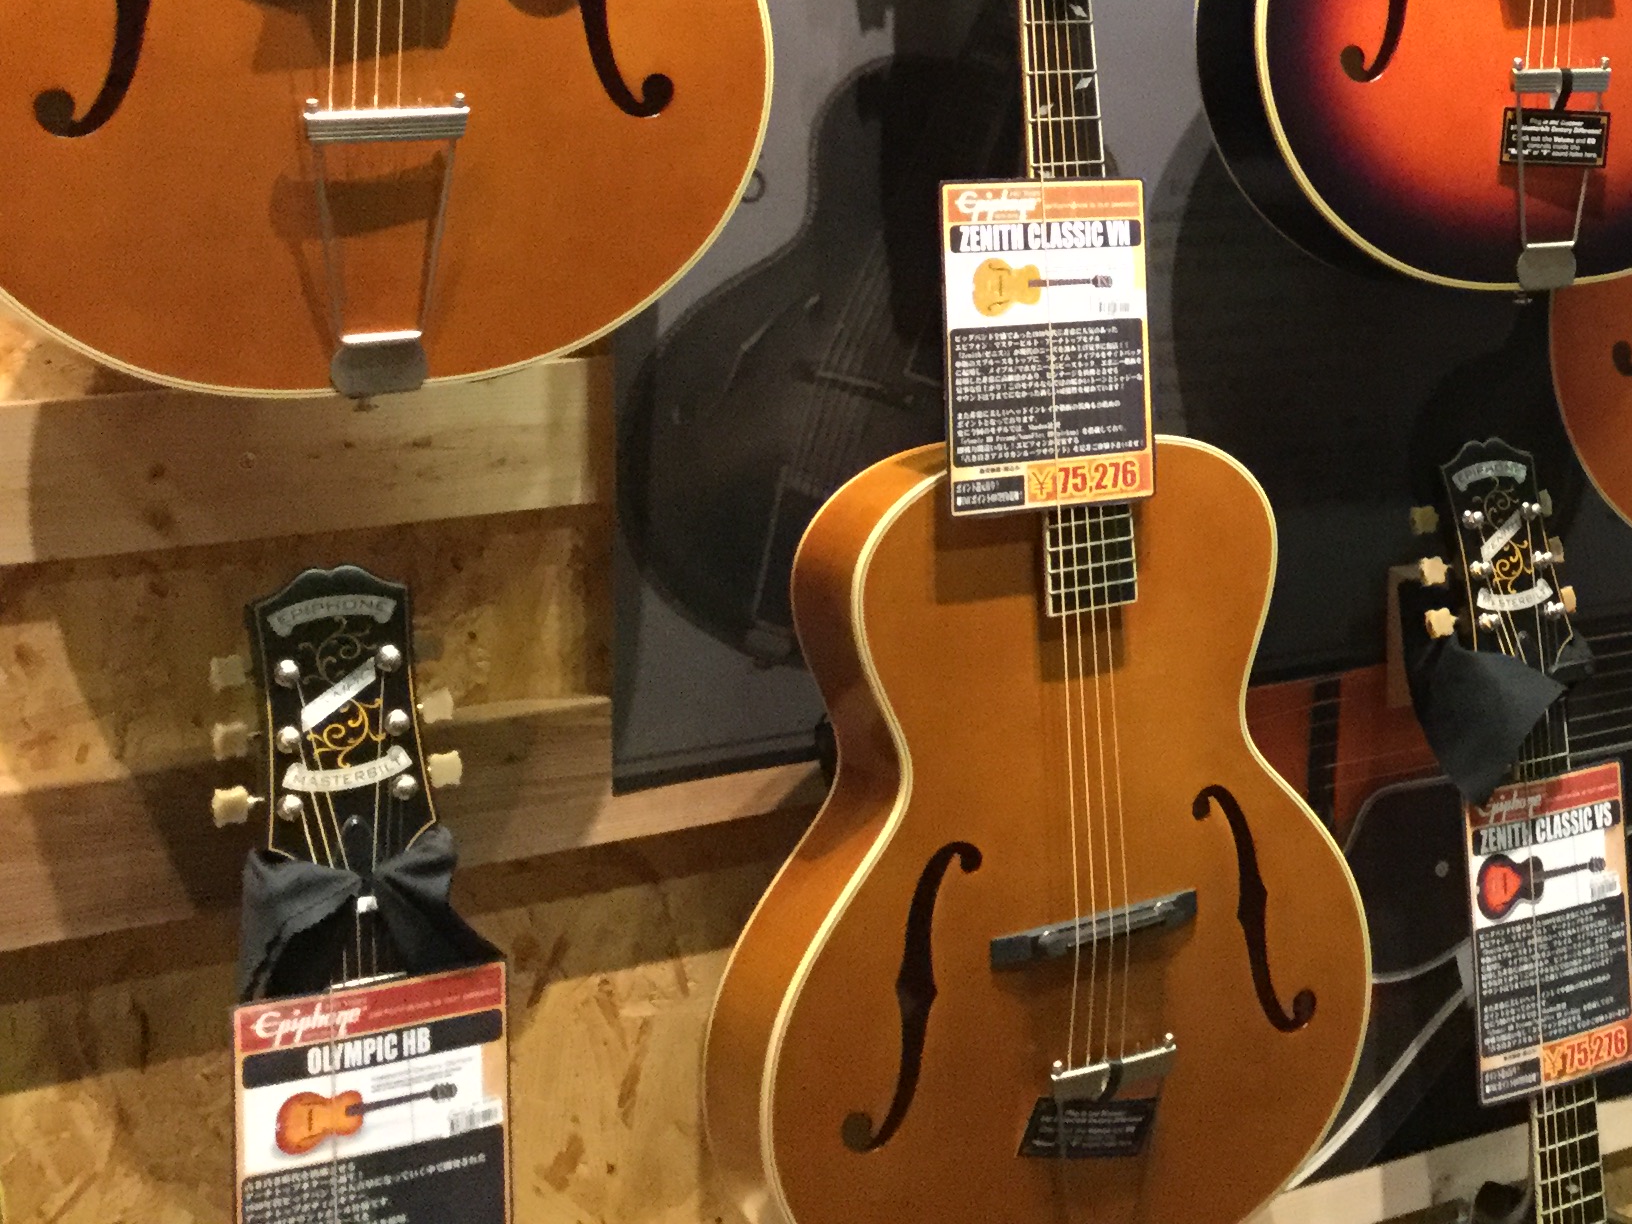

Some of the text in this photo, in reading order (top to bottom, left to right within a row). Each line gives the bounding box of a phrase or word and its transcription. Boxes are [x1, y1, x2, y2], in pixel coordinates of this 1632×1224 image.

[959, 219, 1131, 253] ZENITH CLASSIC VN
[1028, 459, 1138, 502] ¥75,276
[292, 754, 404, 790] MASTERBILT
[1479, 800, 1614, 854] ZENITH CLASSIC VS
[250, 1001, 369, 1047] Epiphone
[306, 1026, 431, 1076] OLYMPIC HB
